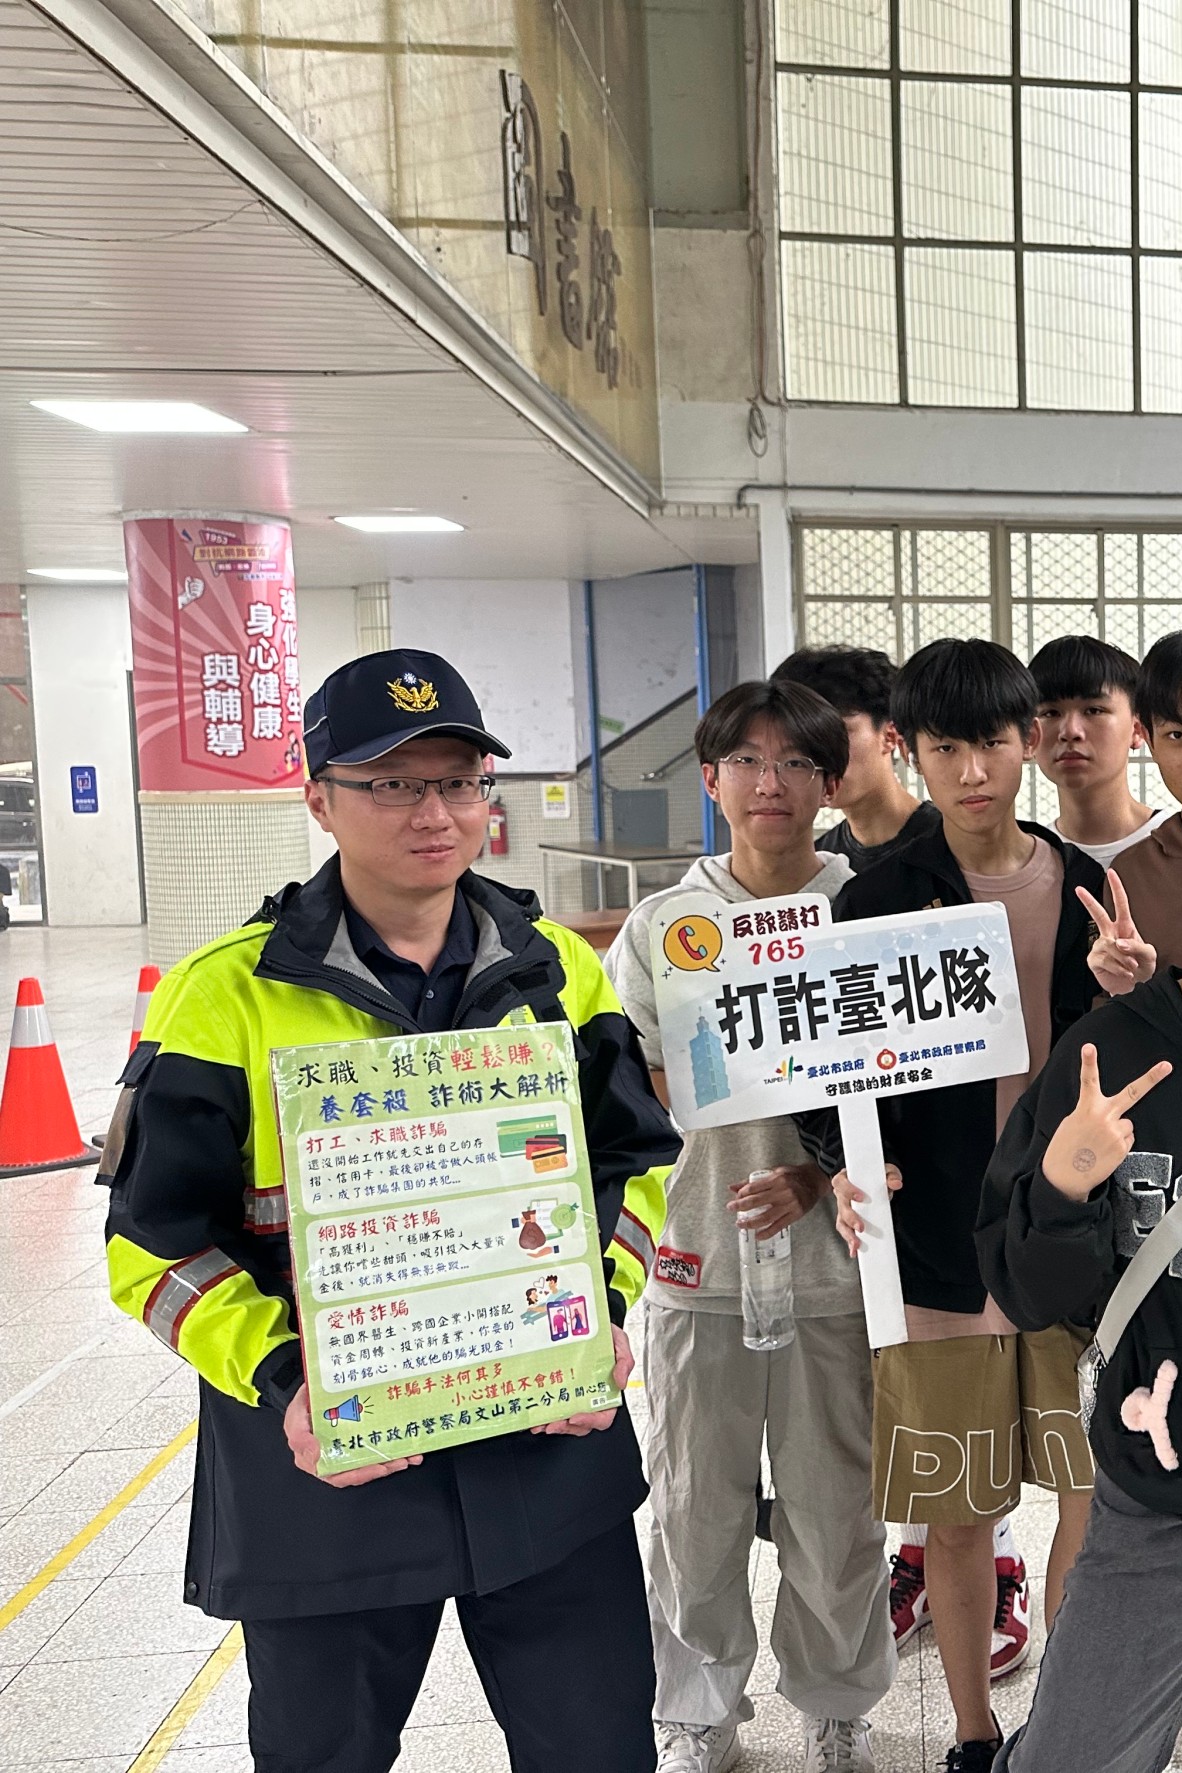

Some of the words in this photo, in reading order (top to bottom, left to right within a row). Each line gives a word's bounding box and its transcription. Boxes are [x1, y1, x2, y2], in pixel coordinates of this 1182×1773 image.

[246, 602, 283, 740] 身心健康
[202, 653, 245, 758] 與輔導
[748, 936, 805, 966] 165
[715, 945, 997, 1056] 打詐臺北隊
[297, 1041, 555, 1088] 求職、投資輕鬆賺？
[806, 1058, 865, 1079] 臺北市政府
[899, 1038, 986, 1065] 臺北市政府警察局
[319, 1088, 410, 1124] 養套殺
[427, 1070, 570, 1110] 詐術大解析
[824, 1067, 934, 1097] 守護您的財產安全
[306, 1120, 448, 1155] 打工、求職詐騙
[318, 1209, 442, 1243] 網路投資詐騙
[326, 1299, 410, 1331] 愛情詐騙
[387, 1362, 504, 1401] 詐騙手法何其多
[450, 1368, 576, 1407] 小心謹慎不會錯！
